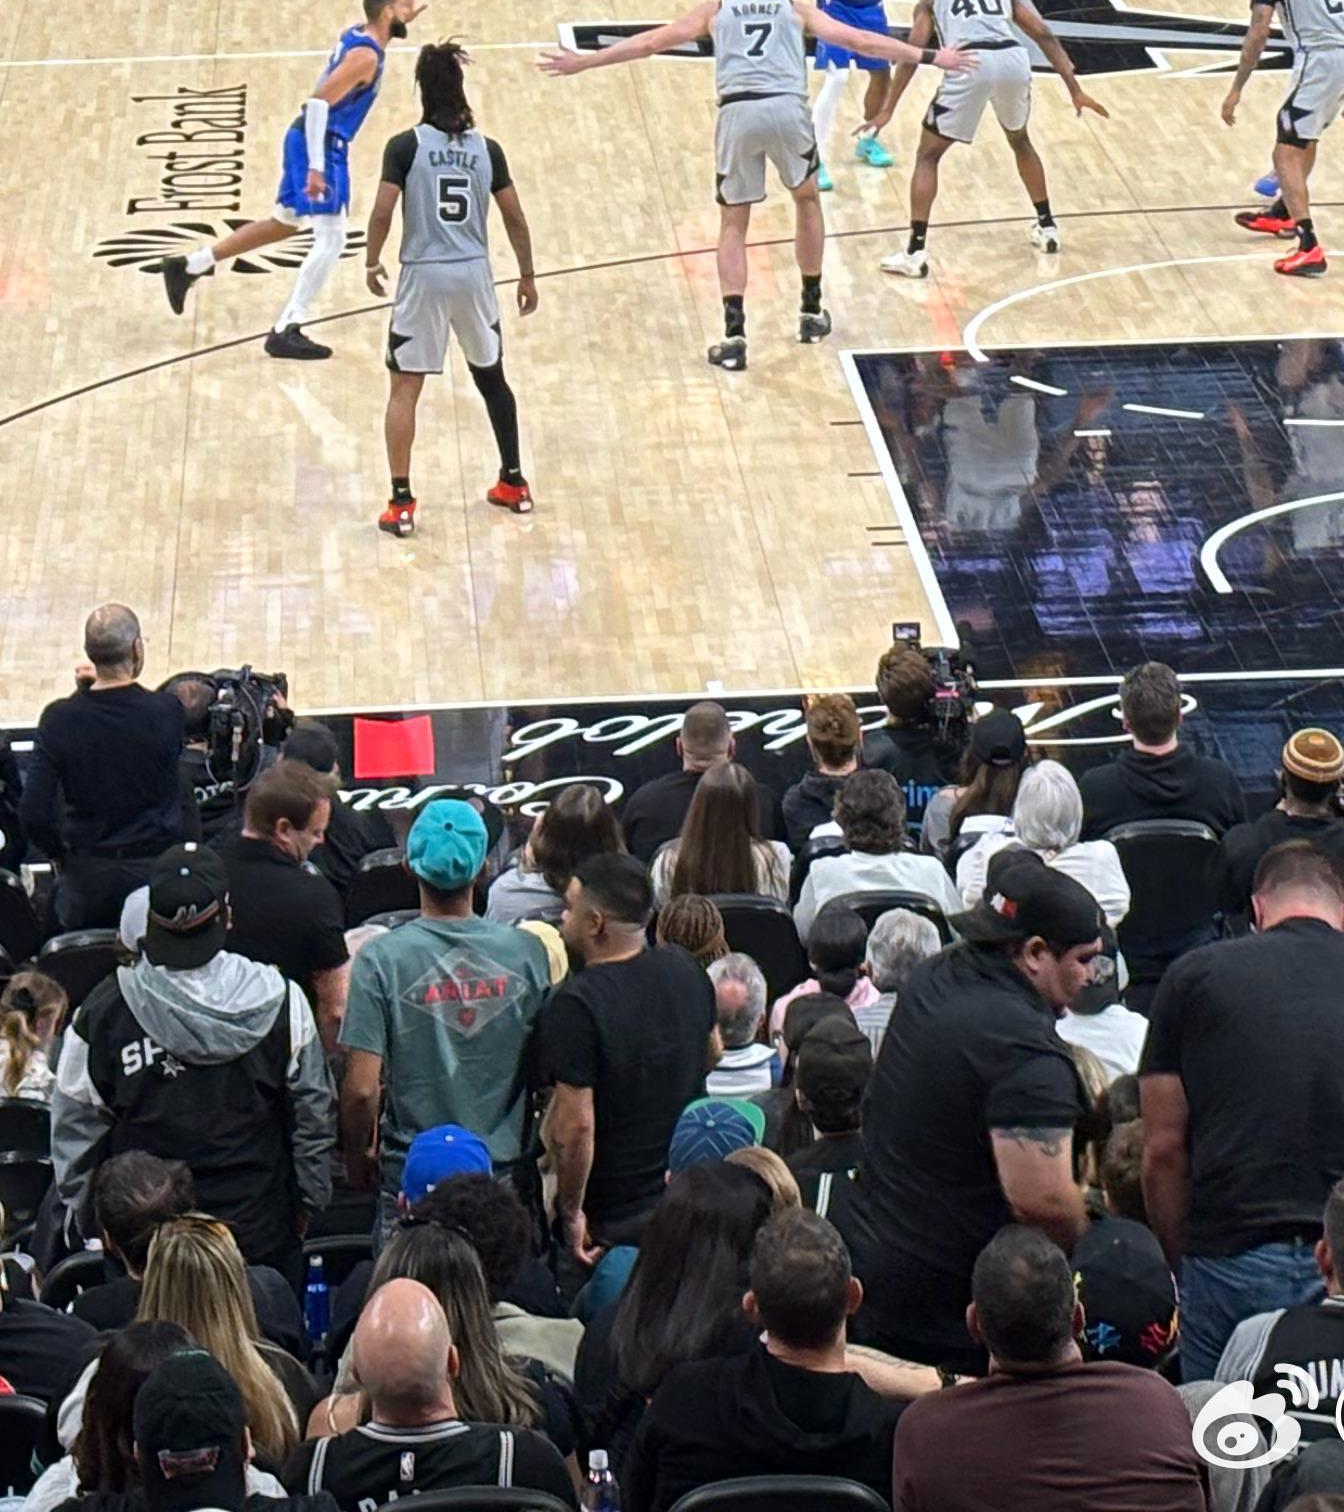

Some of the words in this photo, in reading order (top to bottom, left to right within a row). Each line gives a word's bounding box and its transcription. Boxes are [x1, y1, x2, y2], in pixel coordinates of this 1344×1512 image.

[730, 2, 783, 19] KORNET
[743, 21, 774, 58] 7
[131, 83, 248, 147] Bank
[428, 149, 480, 170] CASTLE
[126, 149, 245, 216] Frost
[436, 174, 472, 225] 5
